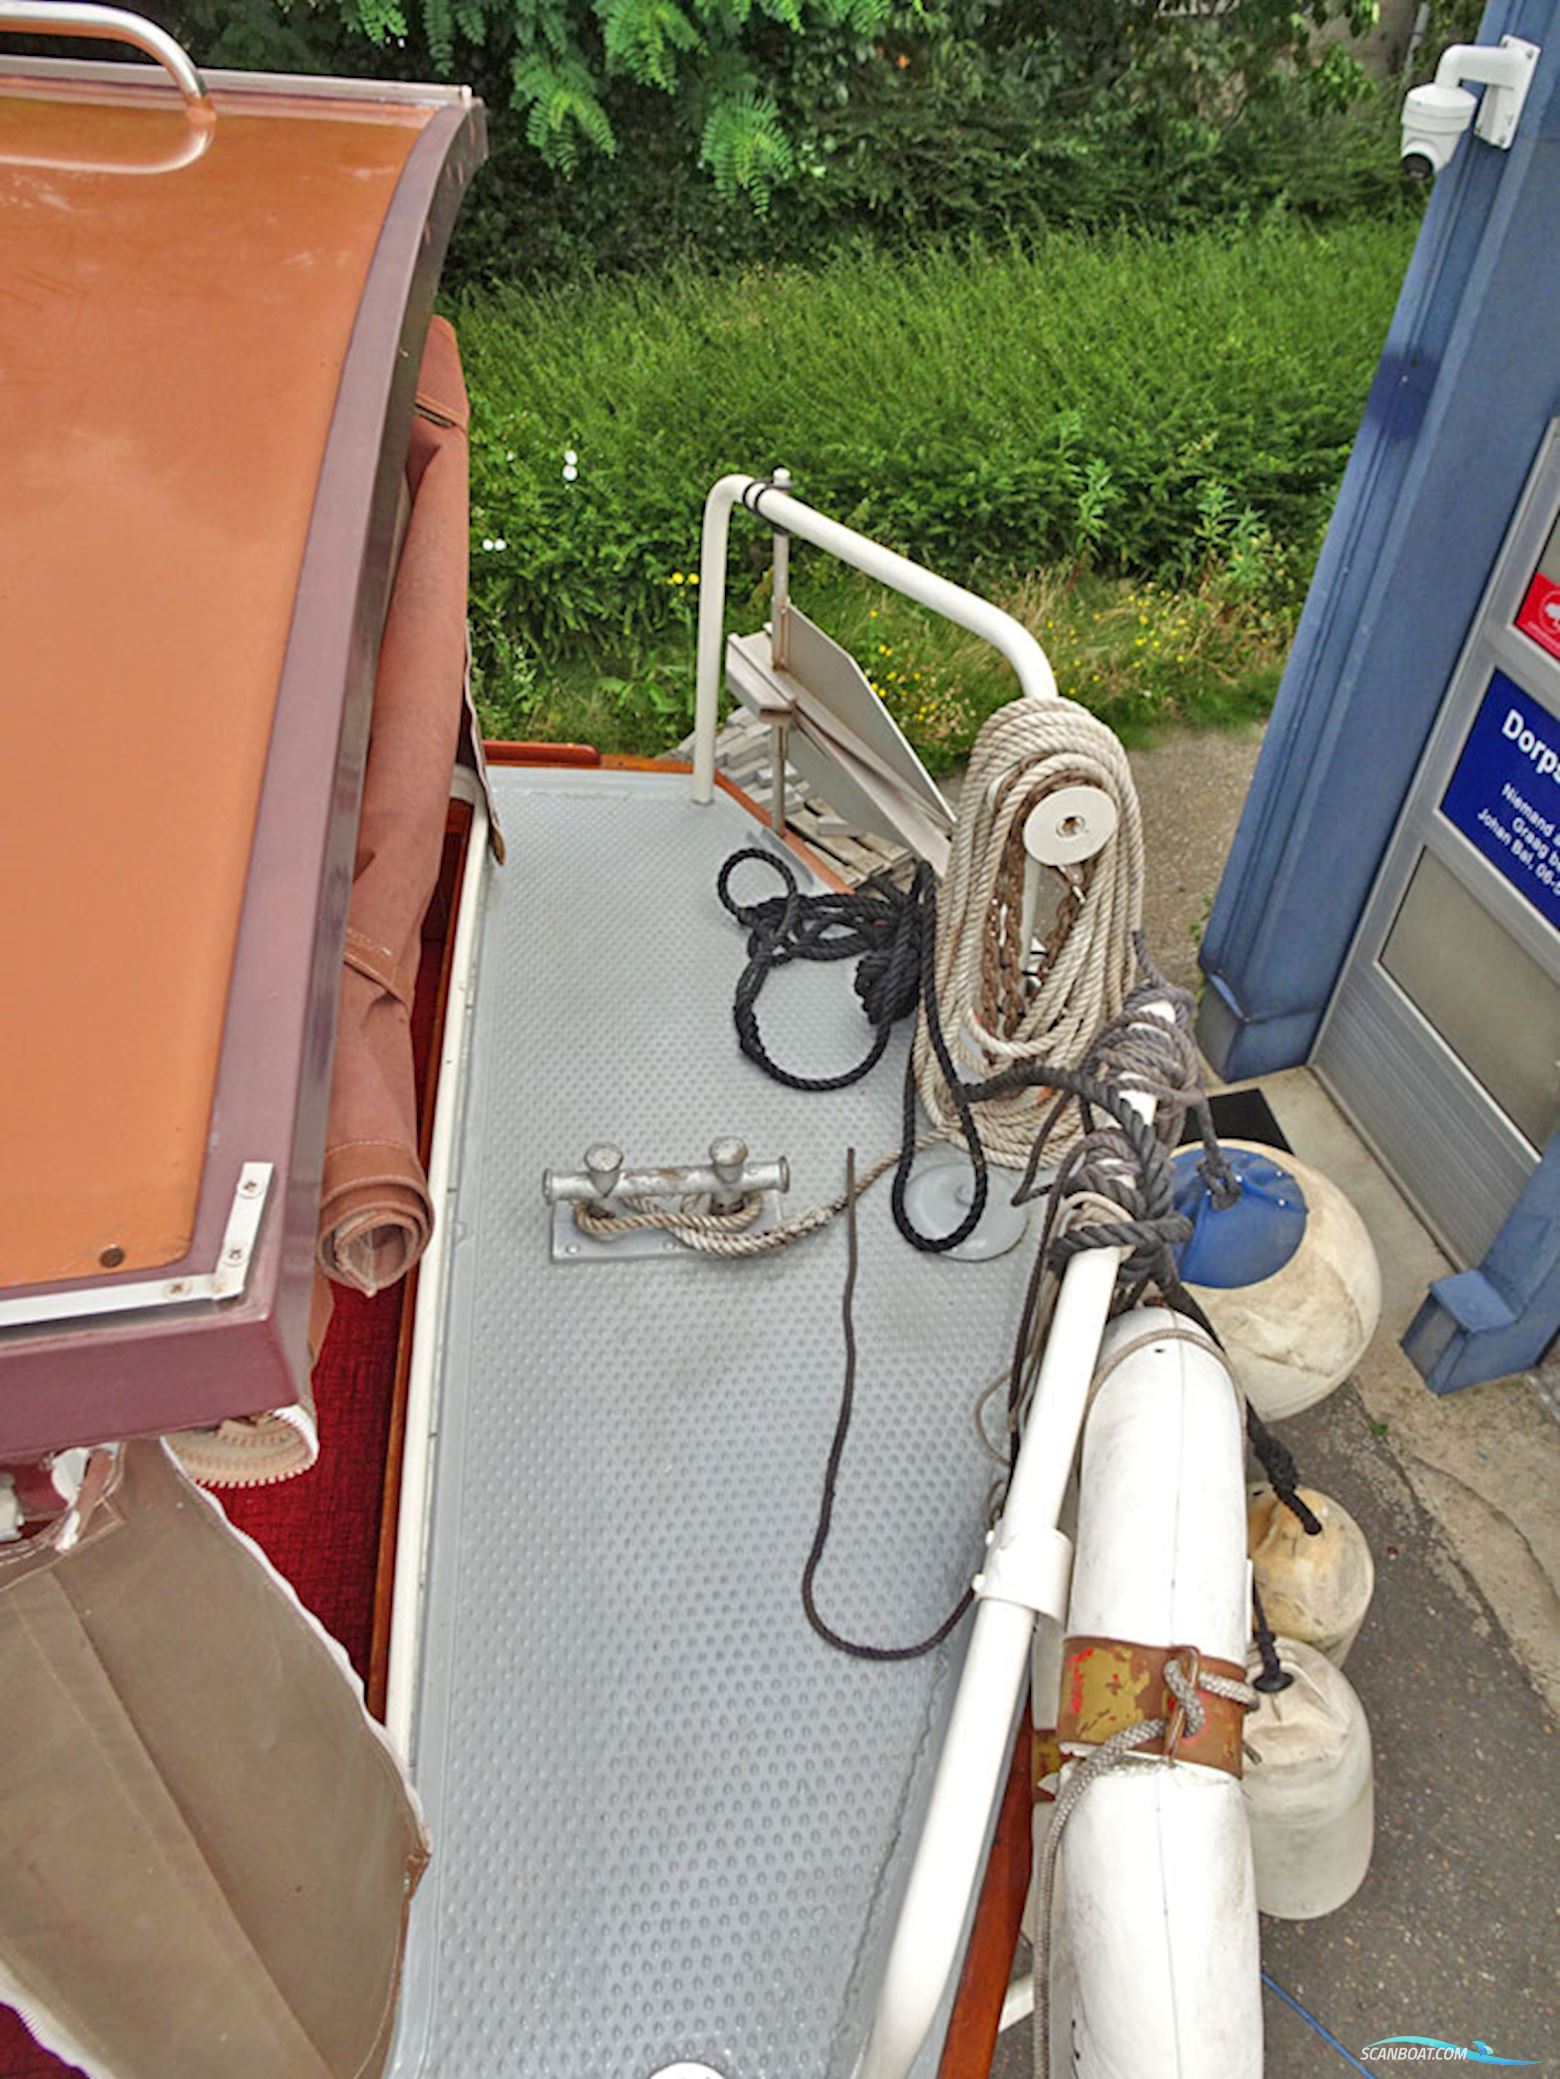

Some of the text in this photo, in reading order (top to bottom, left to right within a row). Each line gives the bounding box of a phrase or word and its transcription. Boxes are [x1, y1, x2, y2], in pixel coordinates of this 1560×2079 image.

[1477, 807, 1512, 846] Johan
[1501, 782, 1556, 838] Niemand
[1512, 816, 1550, 860] Graag
